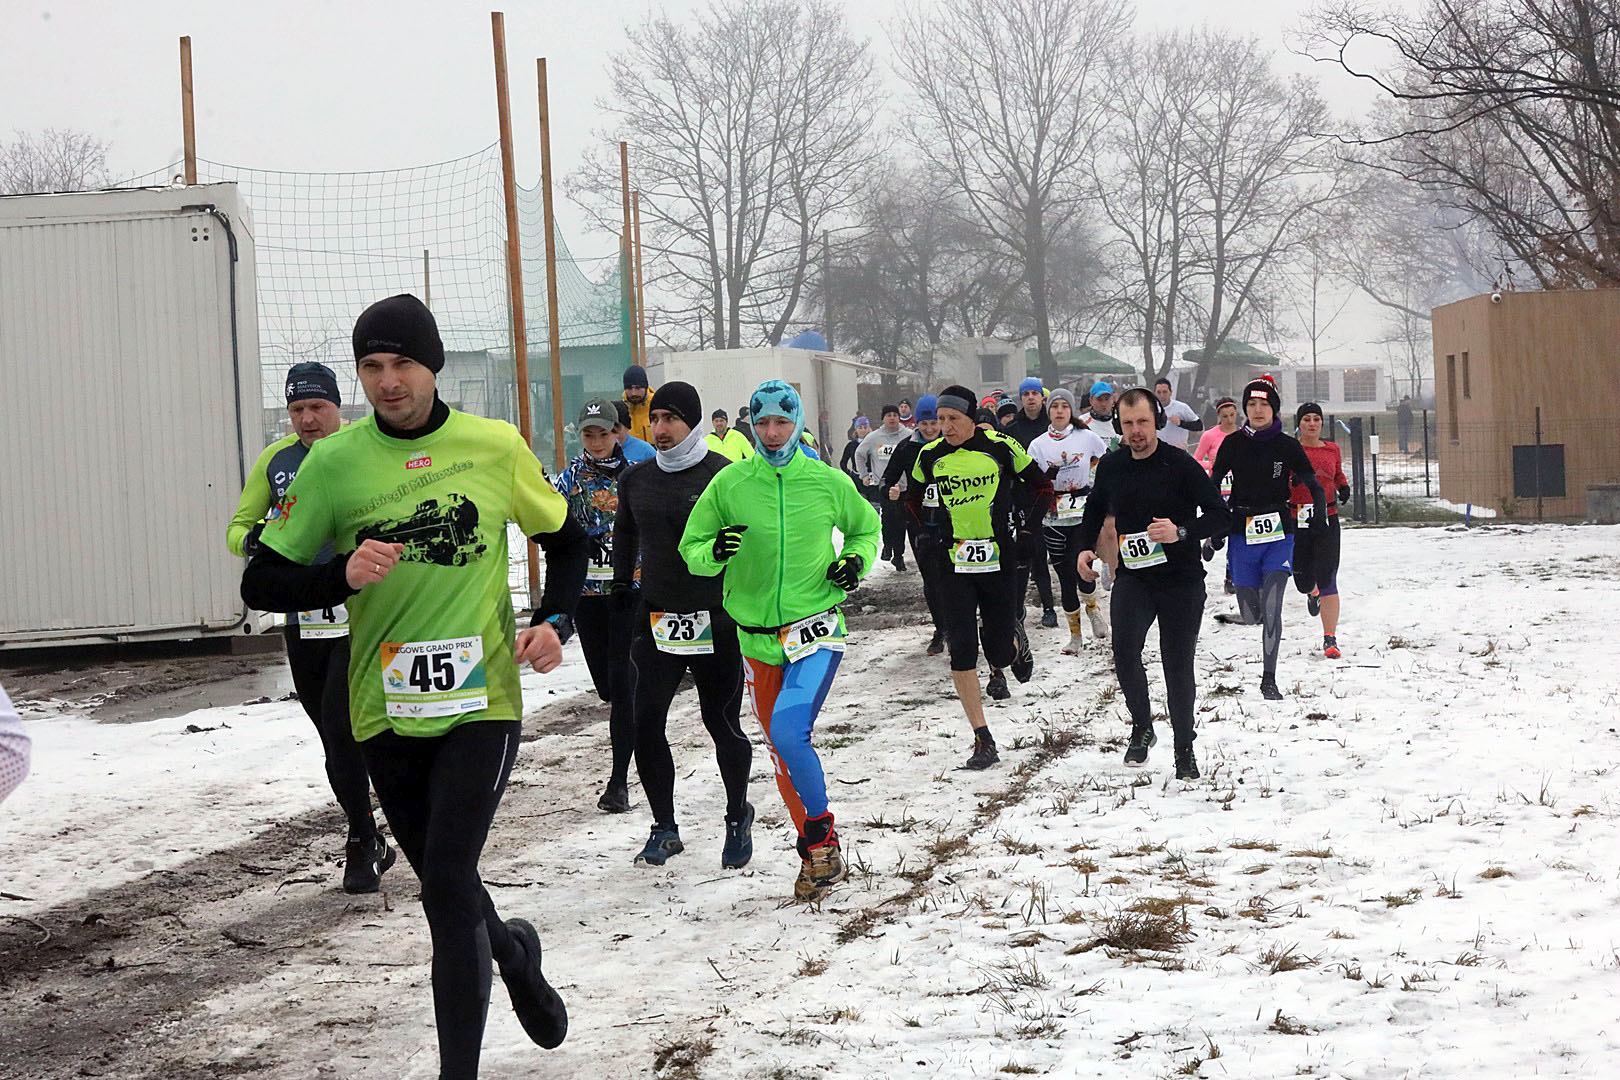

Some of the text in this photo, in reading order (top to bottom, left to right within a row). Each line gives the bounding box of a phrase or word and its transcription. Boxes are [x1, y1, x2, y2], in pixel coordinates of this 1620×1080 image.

[883, 447, 893, 456] 42
[408, 458, 431, 468] HERO
[948, 494, 985, 507] team
[1254, 518, 1273, 535] 59
[966, 545, 987, 563] 25
[1127, 538, 1150, 558] 58
[667, 619, 695, 641] 23
[800, 621, 829, 645] 46
[388, 641, 473, 654] BIEGOWE GRAND PRIX
[409, 652, 456, 692] 45
